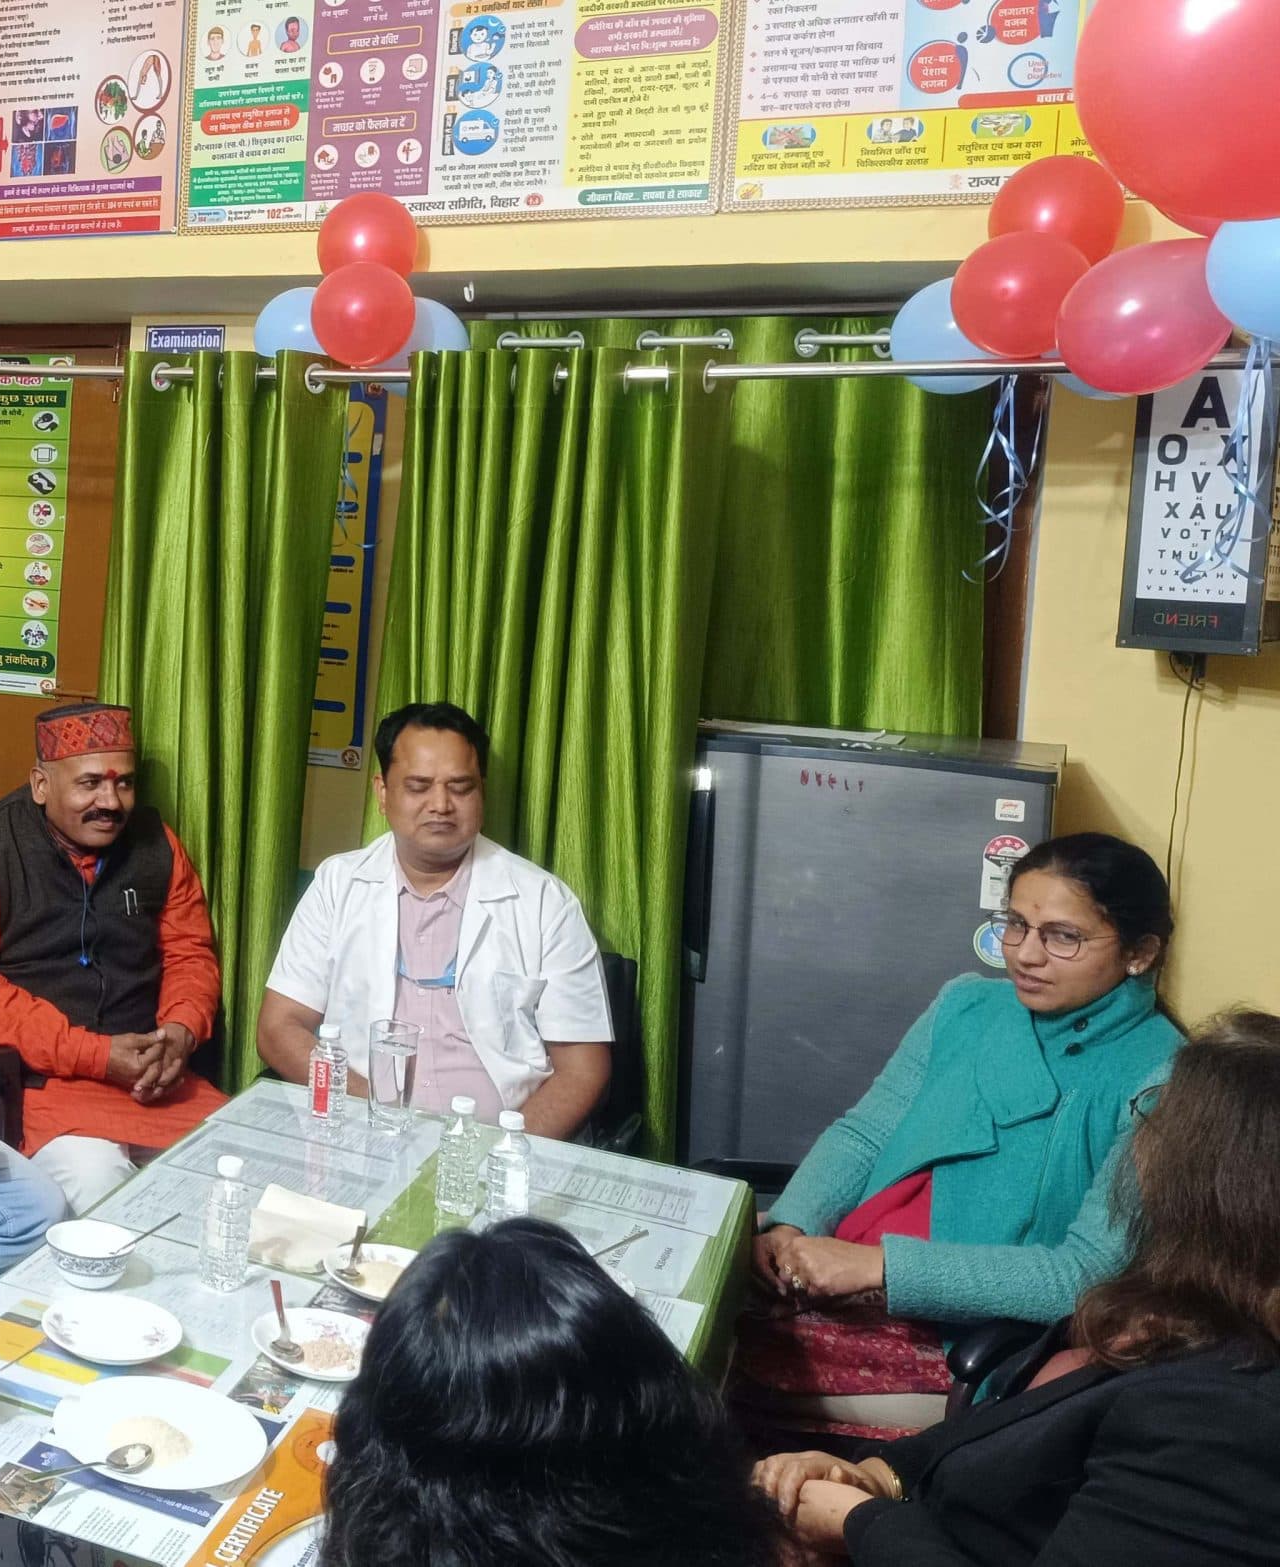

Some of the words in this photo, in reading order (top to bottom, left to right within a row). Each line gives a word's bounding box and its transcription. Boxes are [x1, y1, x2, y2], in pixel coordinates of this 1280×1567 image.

[998, 7, 1035, 16] लगातार
[1005, 18, 1027, 27] वजन
[372, 36, 379, 46] से
[333, 122, 354, 132] मच्छर
[355, 120, 366, 130] को
[968, 176, 1001, 188] राज्य
[409, 199, 445, 212] स्वास्थ्य
[449, 197, 486, 210] समिति,
[491, 195, 520, 208] बिहार
[267, 209, 281, 219] 102
[151, 331, 220, 348] Examination
[23, 395, 58, 406] सुझाव
[1181, 376, 1230, 428] A
[1158, 434, 1188, 465] O
[1154, 471, 1176, 491] H
[1192, 472, 1211, 493] V
[1164, 502, 1180, 518] X
[1190, 503, 1205, 519] A
[1215, 504, 1231, 519] U
[1161, 528, 1171, 538] V
[1180, 529, 1190, 539] O
[1201, 529, 1211, 540] T
[1158, 550, 1166, 559] T
[1172, 550, 1181, 559] M
[1189, 551, 1198, 560] U
[214, 1487, 285, 1562] CERTIFICATE
